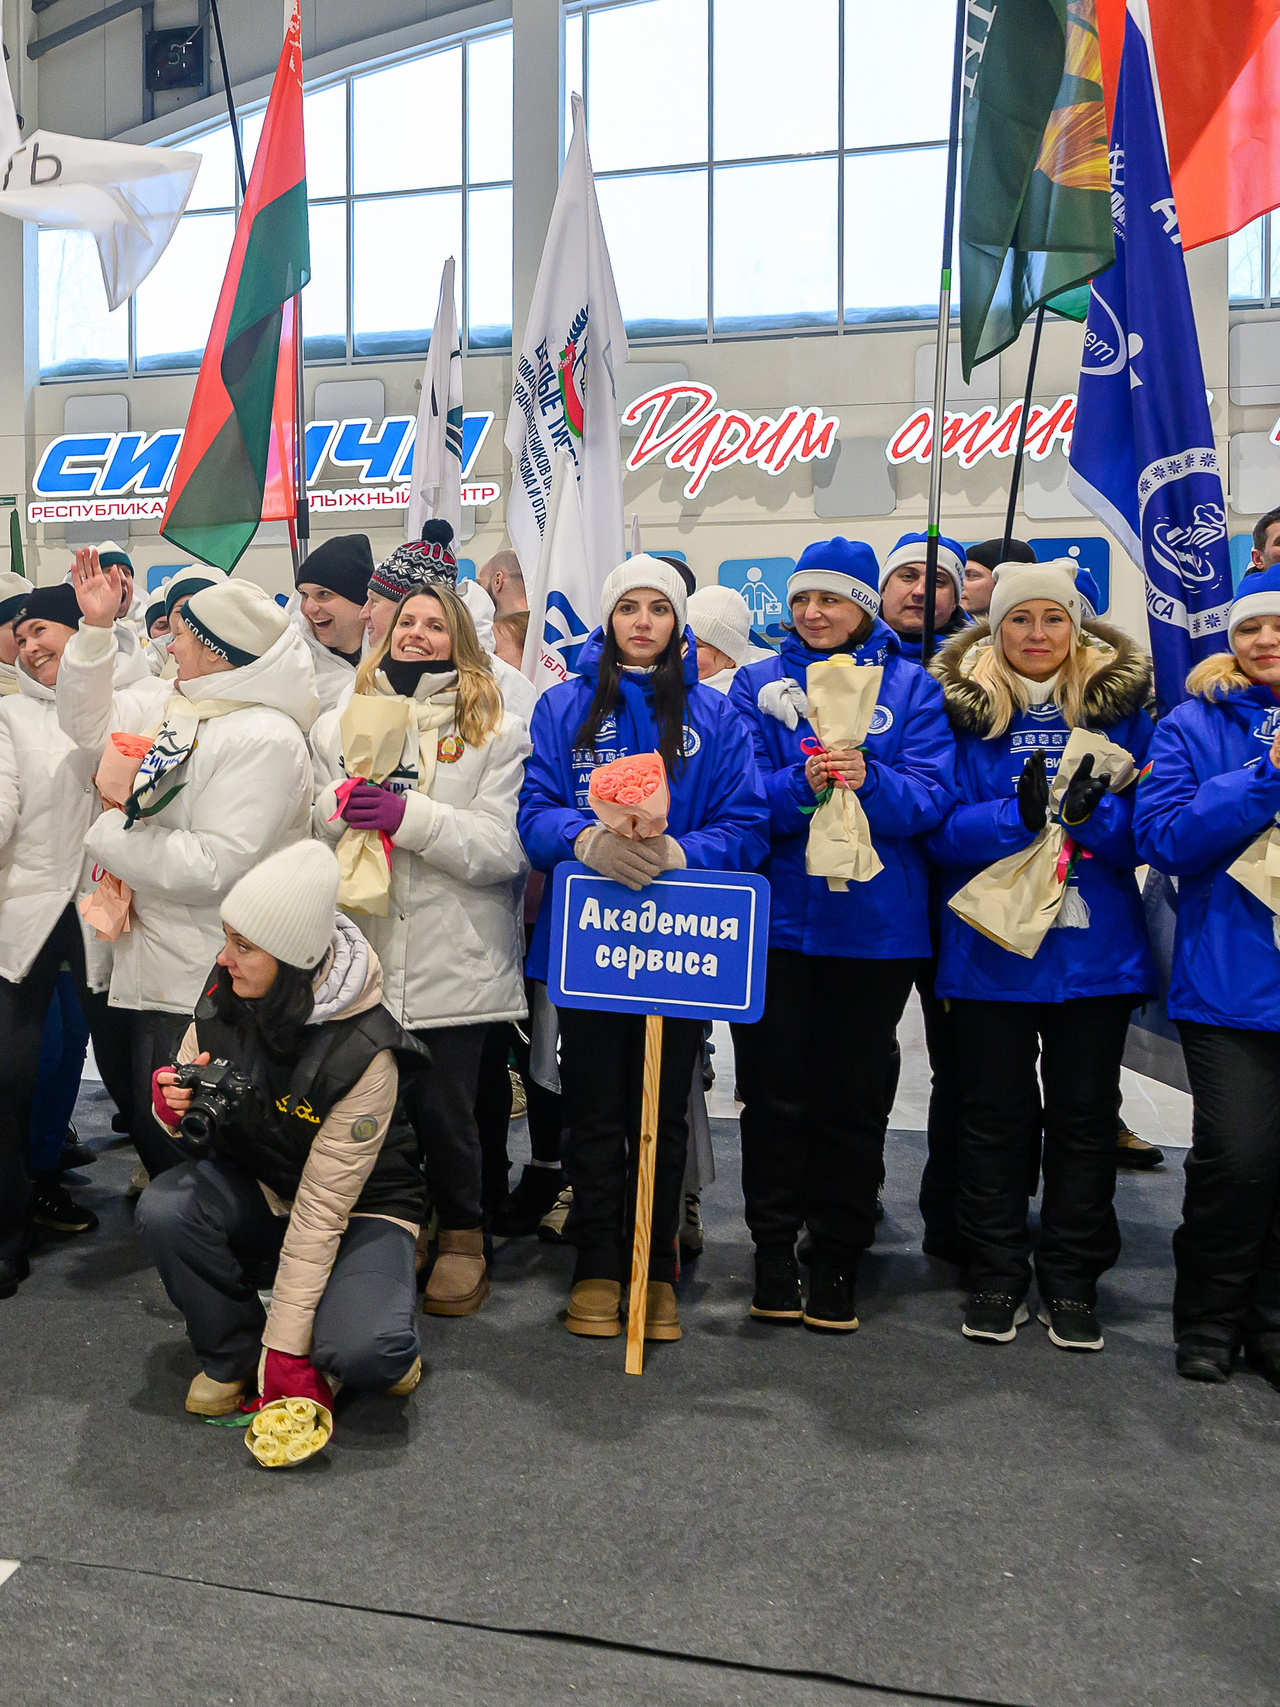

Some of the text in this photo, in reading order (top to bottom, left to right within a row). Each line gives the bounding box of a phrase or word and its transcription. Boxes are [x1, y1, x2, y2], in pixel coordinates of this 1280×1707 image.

[184, 617, 229, 661] БЕЛАРУСЬ
[578, 897, 739, 941] Академия
[595, 944, 718, 980] сервиса
